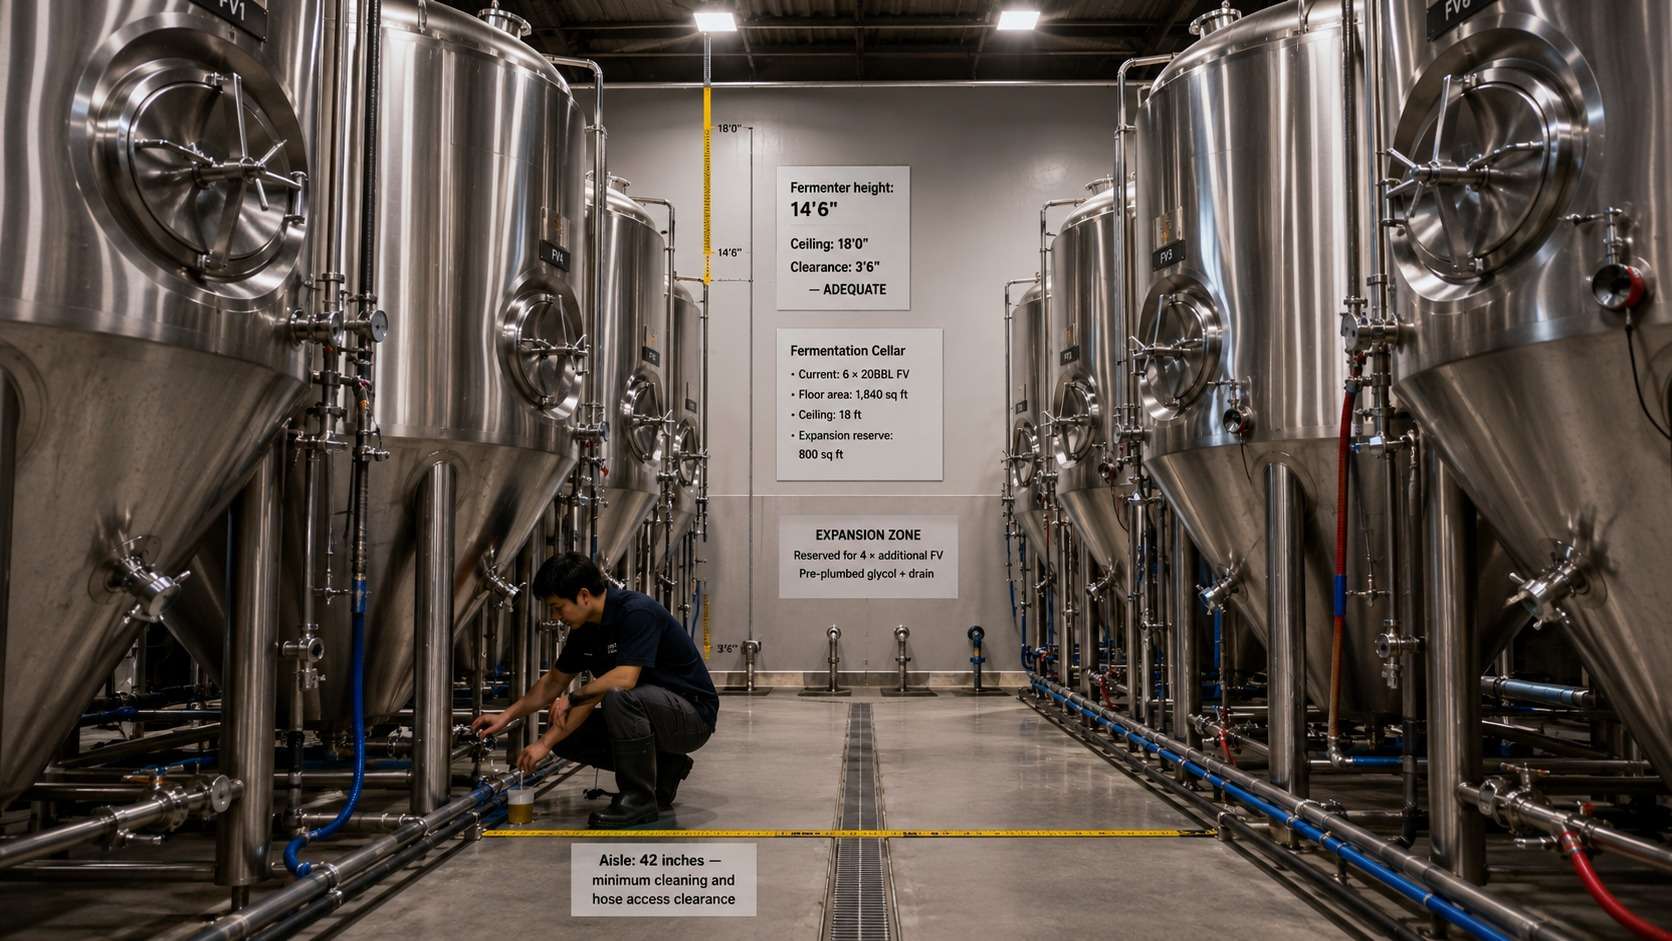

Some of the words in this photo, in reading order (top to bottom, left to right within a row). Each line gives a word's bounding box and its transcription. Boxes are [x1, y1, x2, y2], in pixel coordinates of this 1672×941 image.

[718, 124, 742, 133] 18'0"
[791, 182, 851, 193] Fermenter
[854, 181, 893, 196] height:
[791, 201, 837, 217] 14'6"
[791, 238, 834, 252] Ceiling:
[838, 238, 868, 249] 18'0"
[718, 248, 742, 257] 14'6"
[791, 261, 851, 272] Clearance:
[856, 261, 880, 272] 3'6"
[823, 283, 887, 296] ADEQUATE
[791, 345, 868, 356] Fermentation
[872, 345, 906, 356] Cellar
[799, 369, 839, 379] Current:
[843, 369, 849, 379] 6
[861, 369, 894, 379] 20BBL
[897, 369, 909, 379] FV
[799, 389, 825, 399] Floor
[856, 389, 883, 400] 1,840
[885, 392, 897, 401] sq
[900, 389, 908, 399] ft
[799, 409, 835, 422] Ceiling:
[839, 410, 851, 419] 18
[853, 409, 862, 419] ft
[799, 430, 850, 442] Expansion
[799, 449, 818, 459] 800
[820, 448, 832, 461] sq
[835, 449, 843, 459] ft
[816, 529, 884, 540] EXPANSION
[888, 529, 921, 540] ZONE
[794, 550, 840, 560] Reserved
[843, 550, 857, 560] for
[860, 550, 867, 560] 4
[878, 550, 927, 560] additional
[931, 550, 943, 560] FV
[800, 568, 864, 581] Pre-plumbed
[867, 569, 896, 580] glycol
[909, 568, 934, 578] drain
